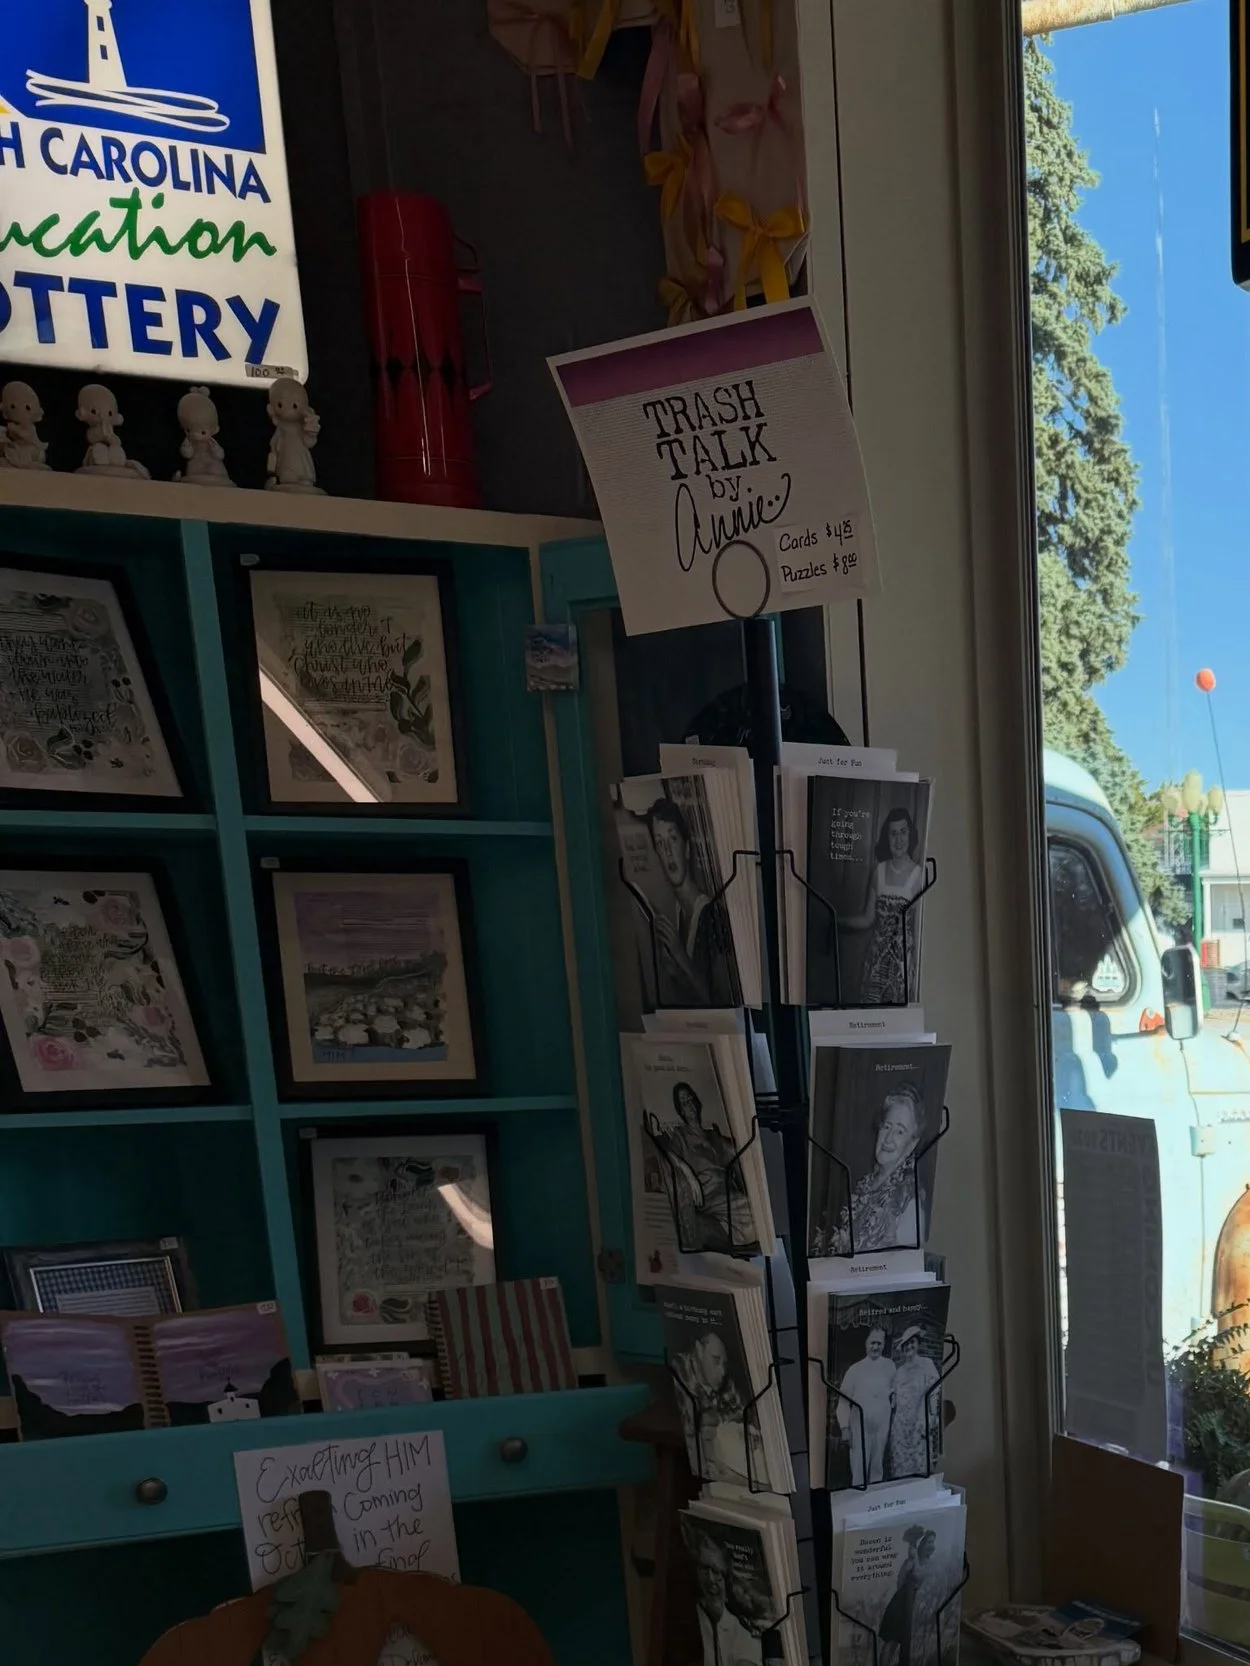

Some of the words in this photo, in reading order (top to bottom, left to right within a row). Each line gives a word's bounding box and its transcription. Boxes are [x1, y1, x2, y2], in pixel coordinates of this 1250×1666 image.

[40, 127, 271, 203] CAROLINA
[0, 270, 280, 366] TTERY
[643, 380, 765, 439] TRASH
[656, 422, 776, 480] TALK
[675, 473, 792, 572] Annie
[779, 529, 818, 552] Cards
[781, 563, 827, 582] Puzzles
[831, 819, 854, 830] going
[849, 1021, 886, 1029] Retirement
[850, 1263, 888, 1274] Retirement
[256, 1443, 380, 1503] Exalting
[385, 1436, 431, 1478] HIM
[344, 1484, 423, 1521] Coming
[352, 1528, 377, 1553] in
[381, 1517, 424, 1542] the
